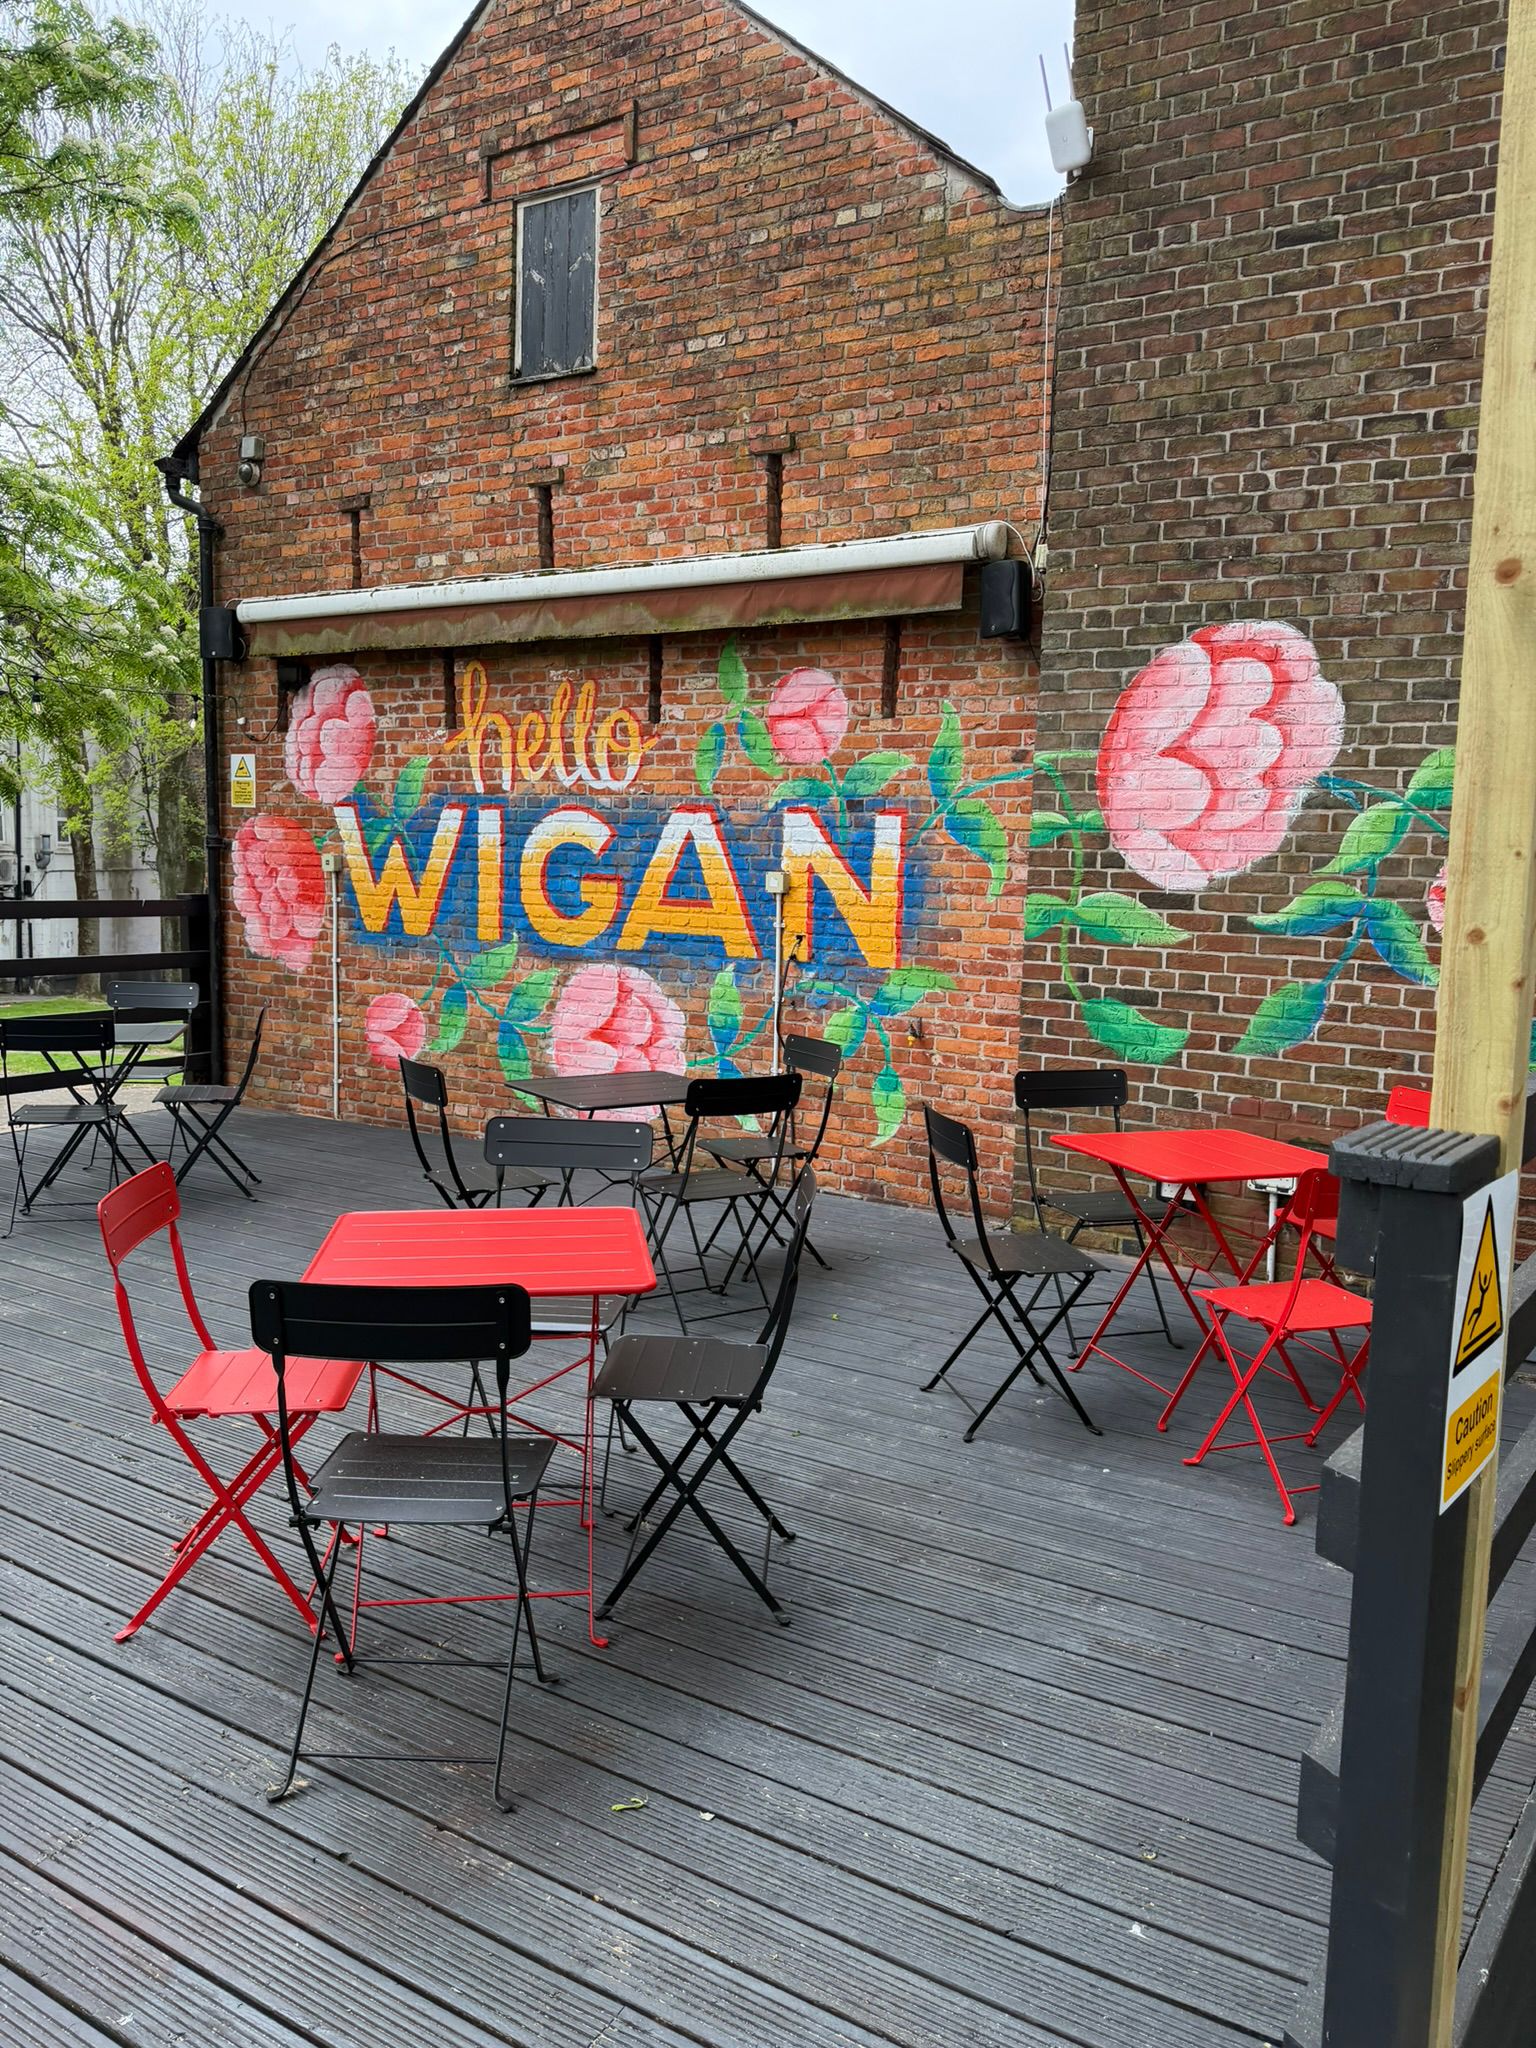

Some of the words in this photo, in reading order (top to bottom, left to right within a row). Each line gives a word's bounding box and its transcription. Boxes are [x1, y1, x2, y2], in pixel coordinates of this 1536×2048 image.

[443, 661, 660, 793] hello
[333, 803, 908, 970] WIGAN
[1446, 1445, 1473, 1480] Slippery
[1474, 1420, 1496, 1451] surface
[1455, 1393, 1493, 1445] Caution
